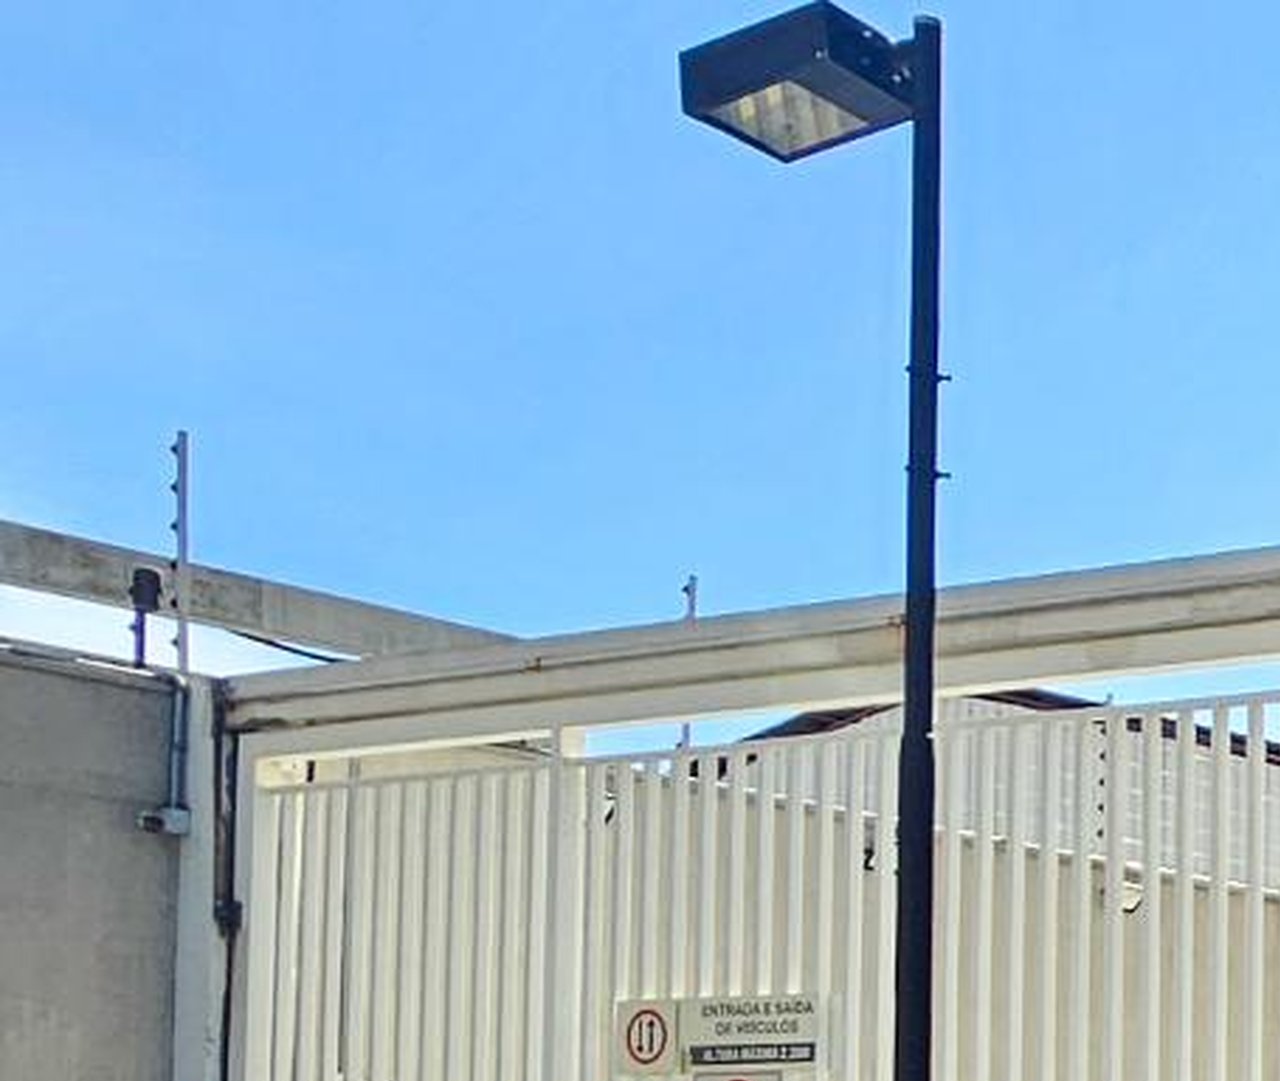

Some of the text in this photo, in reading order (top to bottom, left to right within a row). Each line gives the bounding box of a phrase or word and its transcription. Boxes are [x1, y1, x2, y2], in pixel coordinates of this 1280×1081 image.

[701, 1001, 761, 1018] ENTRADA
[763, 1001, 772, 1017] E
[714, 1020, 732, 1037] DE
